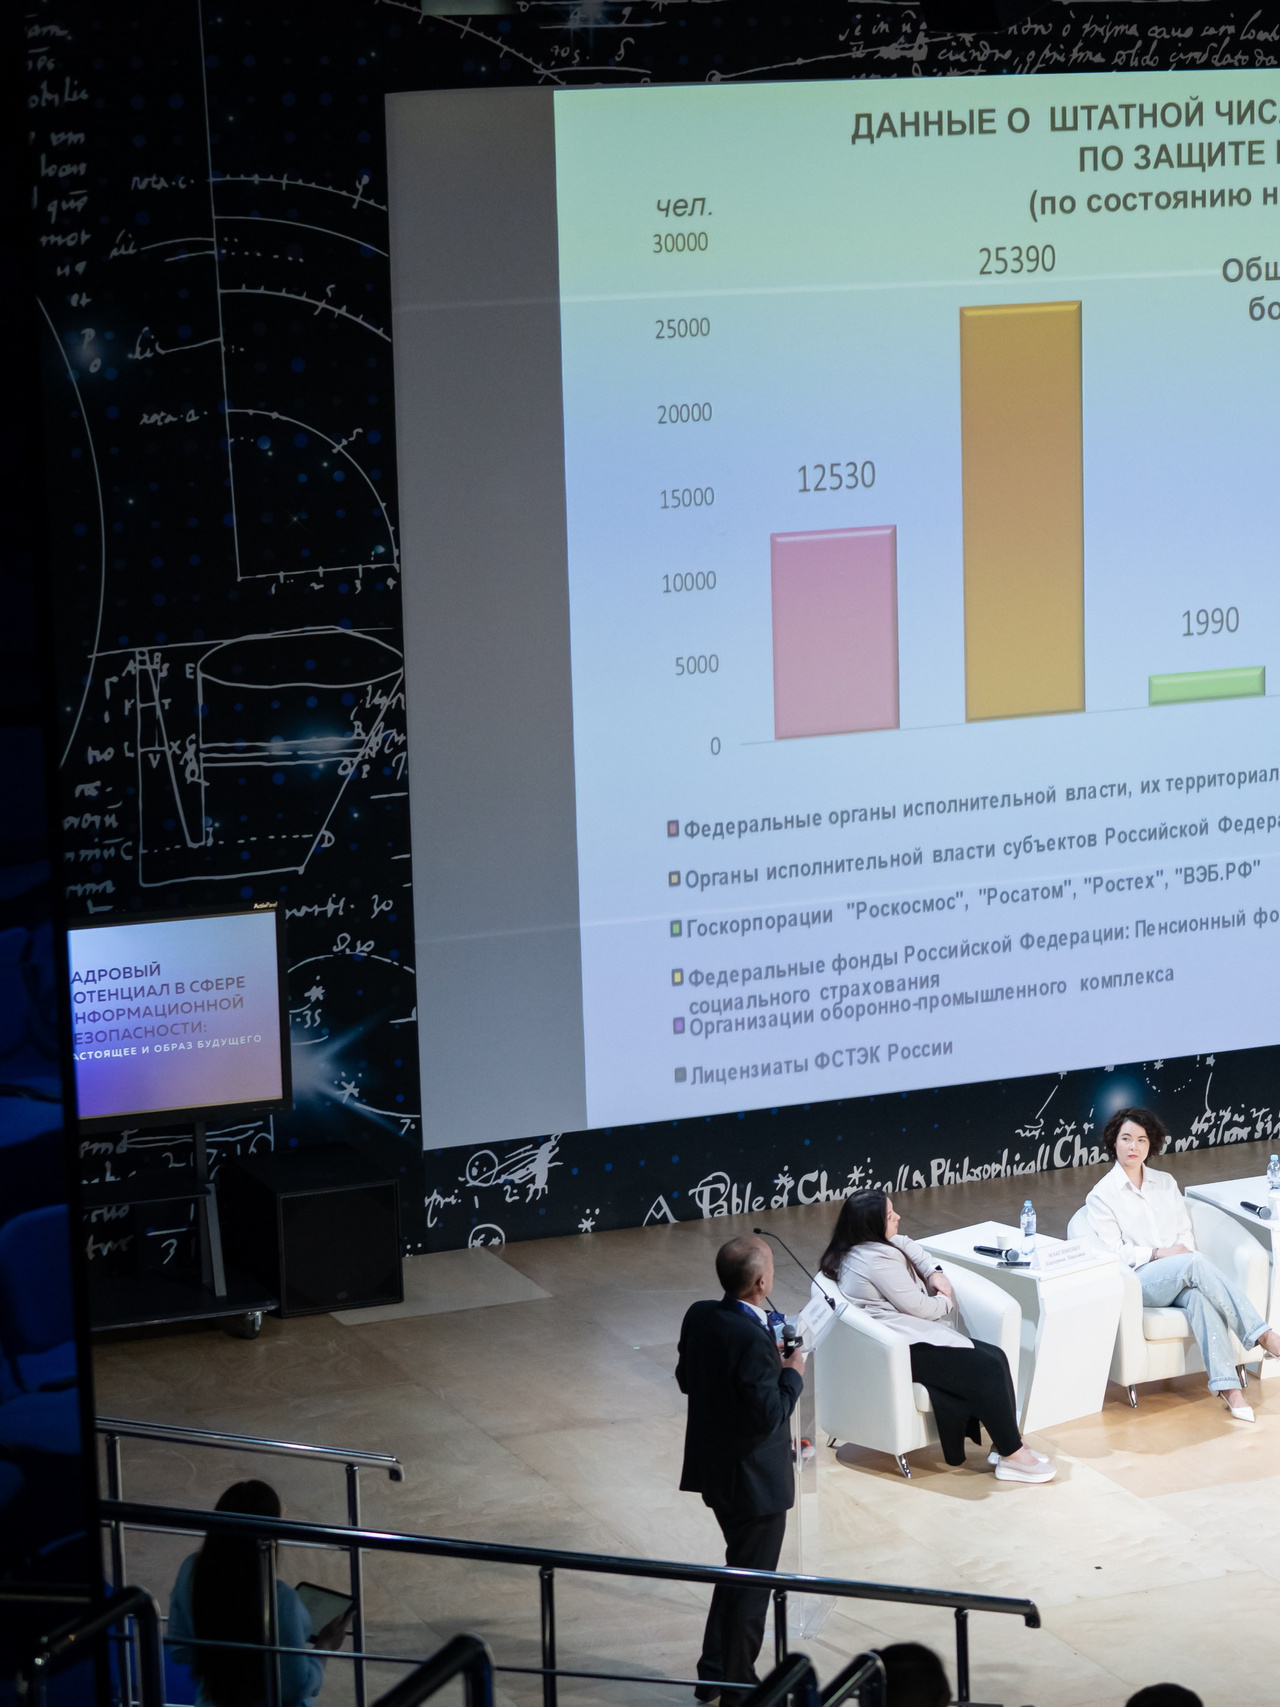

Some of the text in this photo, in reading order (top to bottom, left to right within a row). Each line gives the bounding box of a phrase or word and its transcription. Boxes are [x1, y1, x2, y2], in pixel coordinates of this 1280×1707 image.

[852, 109, 996, 145] ДАННЫЕ
[1008, 108, 1029, 133] О
[1051, 96, 1203, 131] ШТАТНОЙ
[1080, 146, 1123, 172] ПО
[1134, 140, 1265, 172] ЗАЩИТЕ
[657, 198, 712, 217] чел.
[1030, 190, 1076, 222] (по
[1087, 188, 1251, 213] состоянию
[653, 232, 708, 253] 30000
[980, 245, 1055, 275] 25390
[656, 318, 710, 339] 25000
[658, 403, 712, 424] 20000
[798, 461, 875, 492] 12530
[661, 487, 714, 509] 15000
[663, 571, 716, 593] 10000
[1183, 607, 1239, 636] 1990
[676, 654, 719, 675] 5000
[711, 737, 721, 755] 0
[684, 813, 822, 840] Федеральные
[829, 805, 895, 828] органы
[904, 786, 1055, 817] исполнительной
[1066, 783, 1131, 801] власти,
[1141, 779, 1160, 794] их
[686, 868, 758, 892] Органы
[767, 847, 922, 880] исполнительной
[933, 844, 995, 863] власти
[1004, 834, 1097, 859] субъектов
[1106, 818, 1208, 845] Российской
[687, 860, 1260, 938] Госкорпорации "Роскосмос", "Росатом", "Ростех", "ВЭБ.РФ"
[689, 960, 825, 988] Федеральные
[832, 952, 897, 975] фонды
[905, 935, 1011, 963] Российской
[1020, 926, 1129, 951] Федерации:
[1136, 910, 1245, 938] Пенсионный
[70, 961, 161, 985] АДРОВЫЙ
[73, 976, 246, 1004] ОТЕНЦИАЛ В СФЕРЕ
[689, 971, 940, 1016] социального страхования
[689, 966, 1175, 1038] Организации оборонно-промышленного комплекса
[75, 994, 244, 1025] НФОРМАЦИОННОЙ
[74, 1021, 207, 1046] ЕЗОПАСНОСТИ:
[142, 1046, 149, 1054] И
[154, 1042, 193, 1053] ОБРАЗ
[197, 1034, 262, 1049] БУДУЩЕГО
[691, 1041, 952, 1085] Лицензиаты ФСТЭК России
